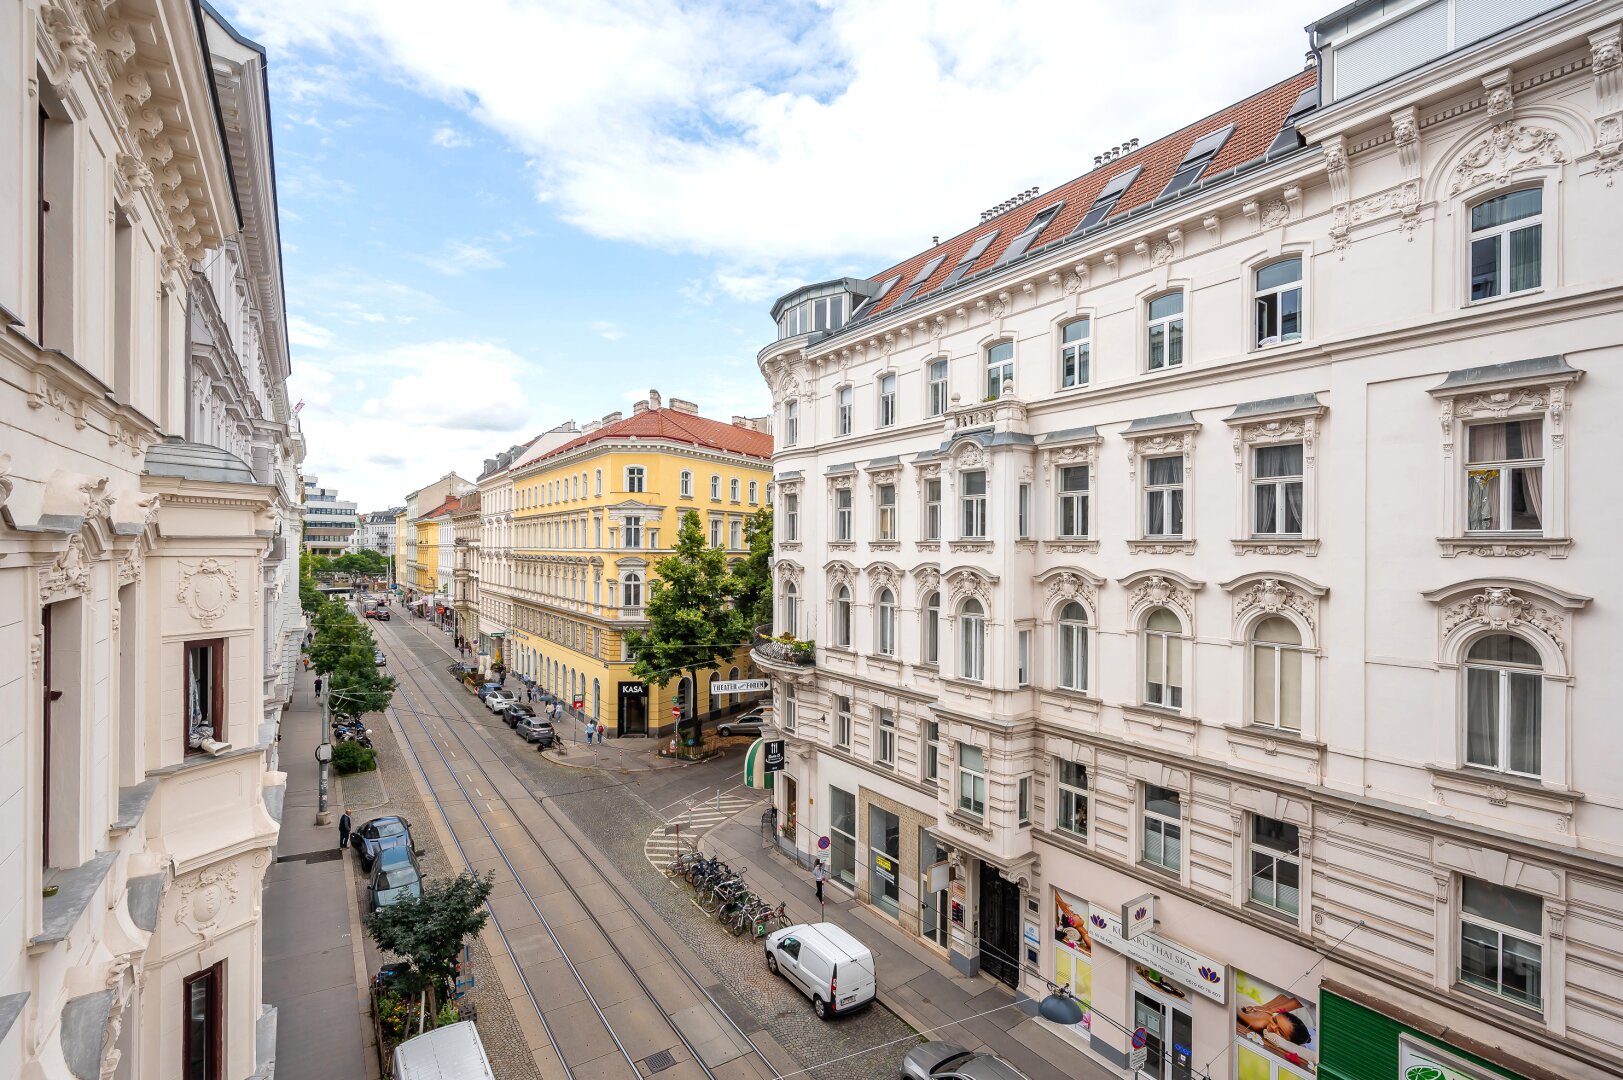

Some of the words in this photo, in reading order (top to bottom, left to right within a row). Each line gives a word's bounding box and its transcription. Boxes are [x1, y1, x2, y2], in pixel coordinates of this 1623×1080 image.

[622, 685, 643, 693] KASA
[713, 683, 737, 691] THEATER
[1151, 943, 1172, 960] THAI
[1175, 955, 1191, 970] SPA
